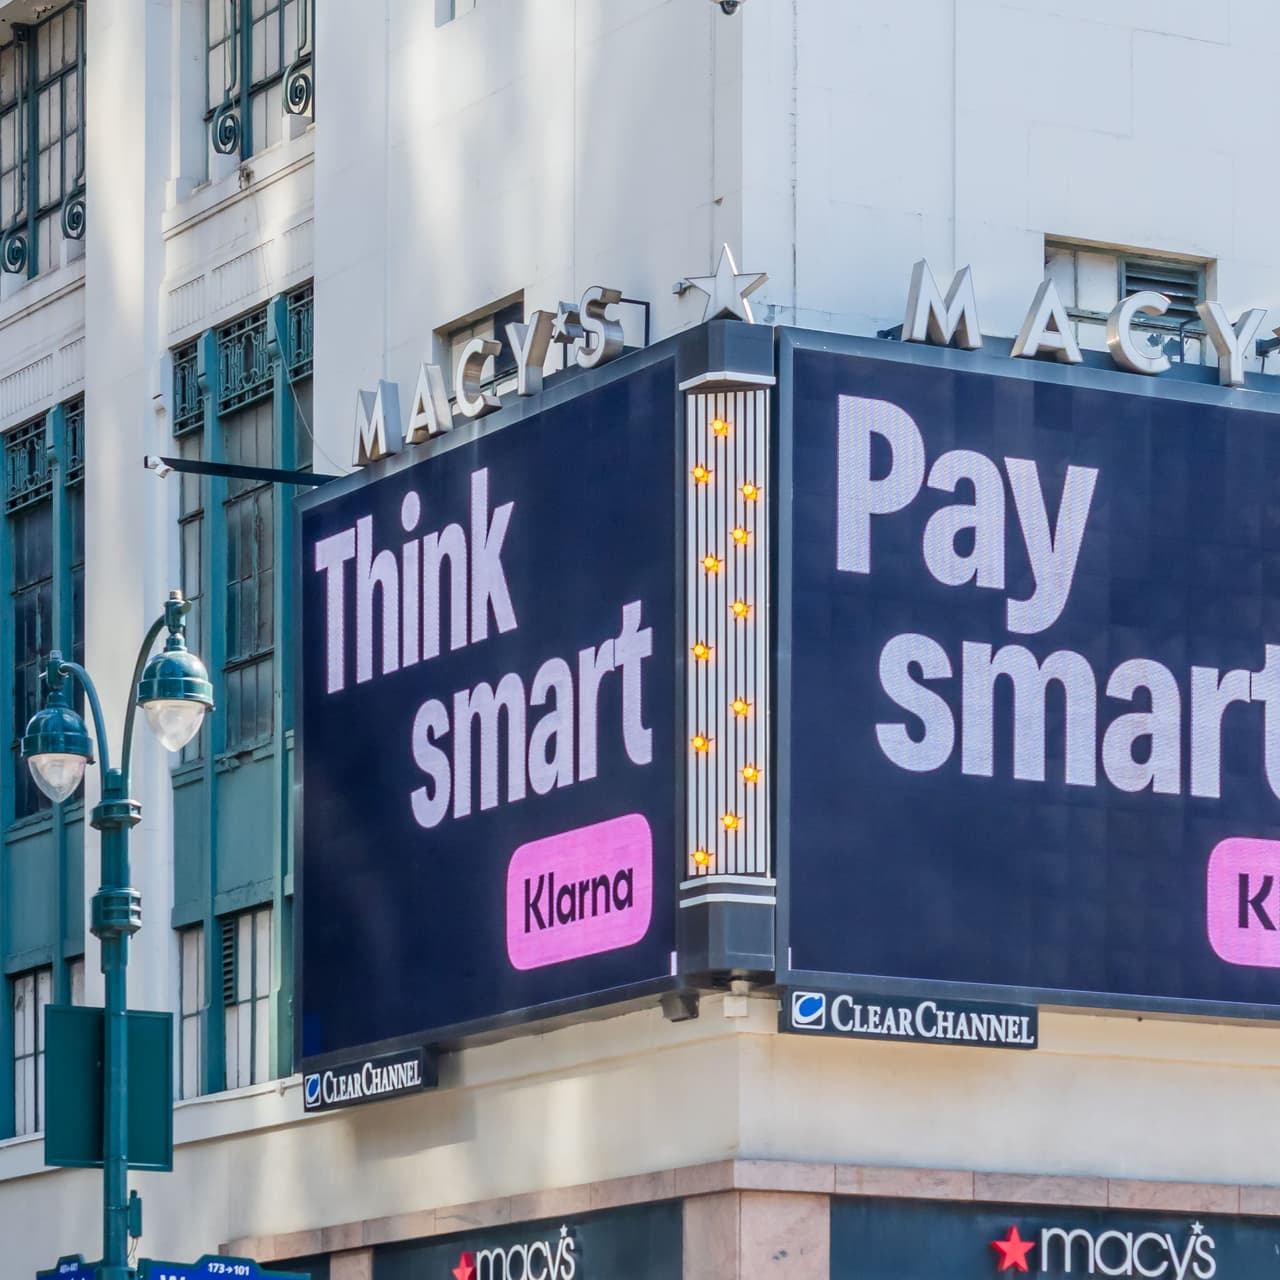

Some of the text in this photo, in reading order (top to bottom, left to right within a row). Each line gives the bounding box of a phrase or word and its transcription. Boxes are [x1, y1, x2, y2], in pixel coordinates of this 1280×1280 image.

[315, 467, 518, 694] Think
[836, 393, 1099, 634] Pay
[411, 600, 653, 829] smart
[524, 867, 634, 934] Klarna
